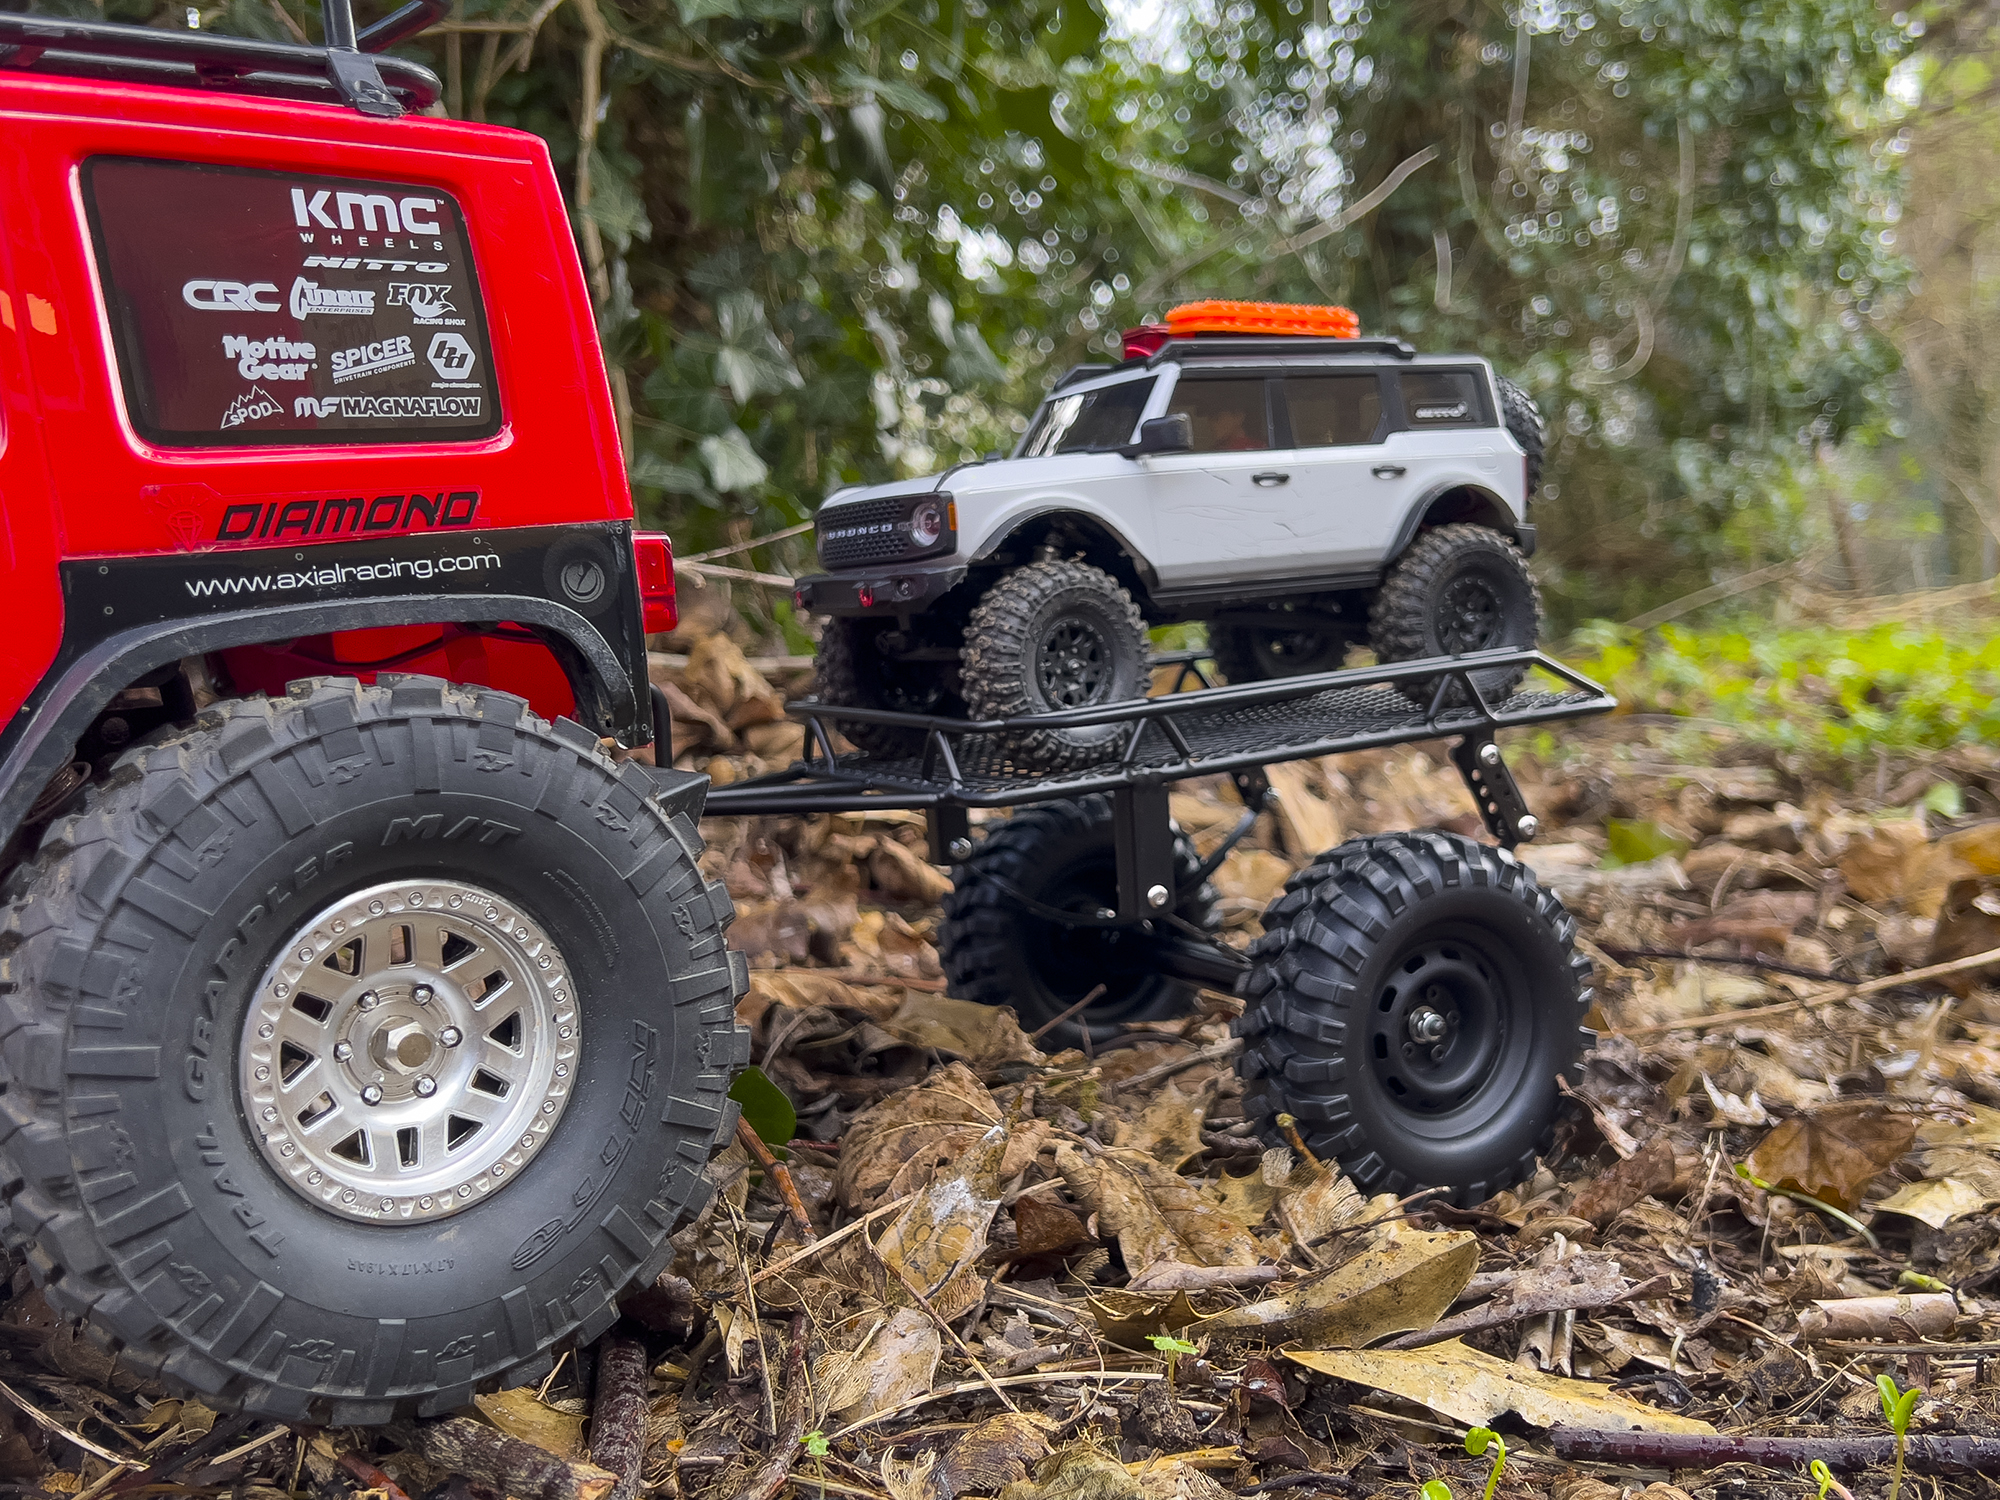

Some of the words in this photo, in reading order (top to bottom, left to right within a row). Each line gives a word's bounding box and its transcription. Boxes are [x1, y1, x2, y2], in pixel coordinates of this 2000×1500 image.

[299, 232, 444, 251] WHEELS
[302, 256, 450, 273] NITTO
[182, 278, 282, 312] CRC
[386, 282, 454, 309] FOX
[308, 305, 374, 316] ENTERPRISES
[412, 317, 443, 326] RACING
[221, 334, 317, 361] Motive
[330, 334, 413, 371] SPICER
[237, 358, 310, 381] Gear
[333, 370, 373, 385] DRIVETRAIN
[373, 359, 416, 375] COMPONENTS
[341, 396, 481, 417] MAGNAFLOW
[216, 490, 479, 541] DIAMOND
[185, 551, 501, 597] www.axialracing.com
[381, 813, 523, 848] M/T
[183, 841, 355, 1102] GRAPPLER
[196, 1122, 285, 1258] TRAIL
